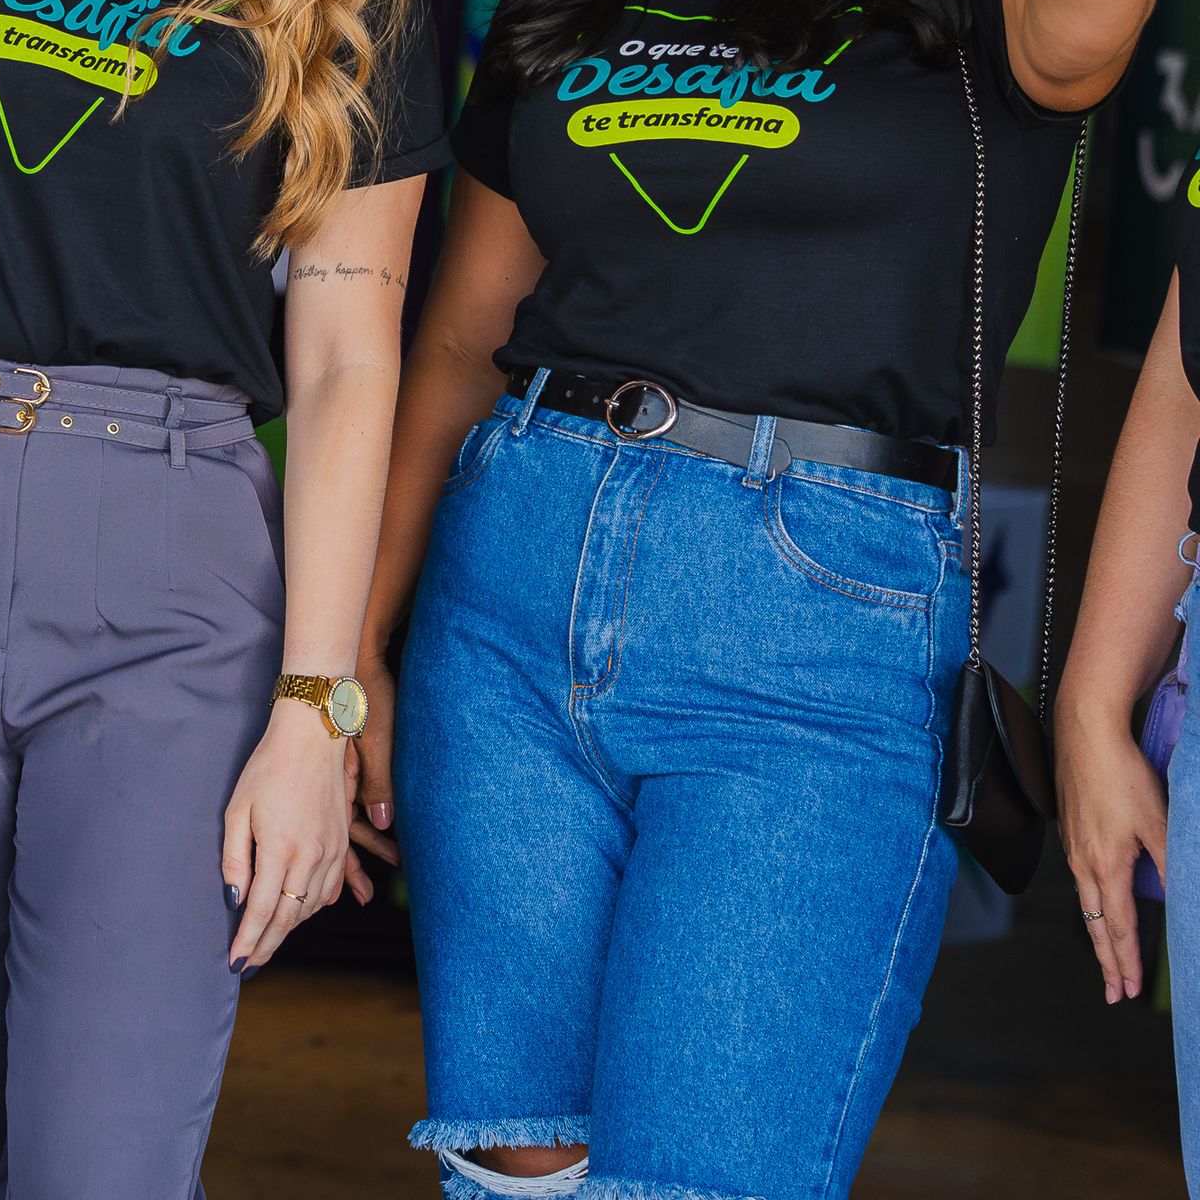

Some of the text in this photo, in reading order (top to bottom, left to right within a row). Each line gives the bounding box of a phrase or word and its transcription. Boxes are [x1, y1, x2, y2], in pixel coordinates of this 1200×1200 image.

[3, 26, 146, 82] transforma
[619, 39, 646, 57] O
[648, 41, 705, 60] que
[582, 107, 785, 135] te transforma
